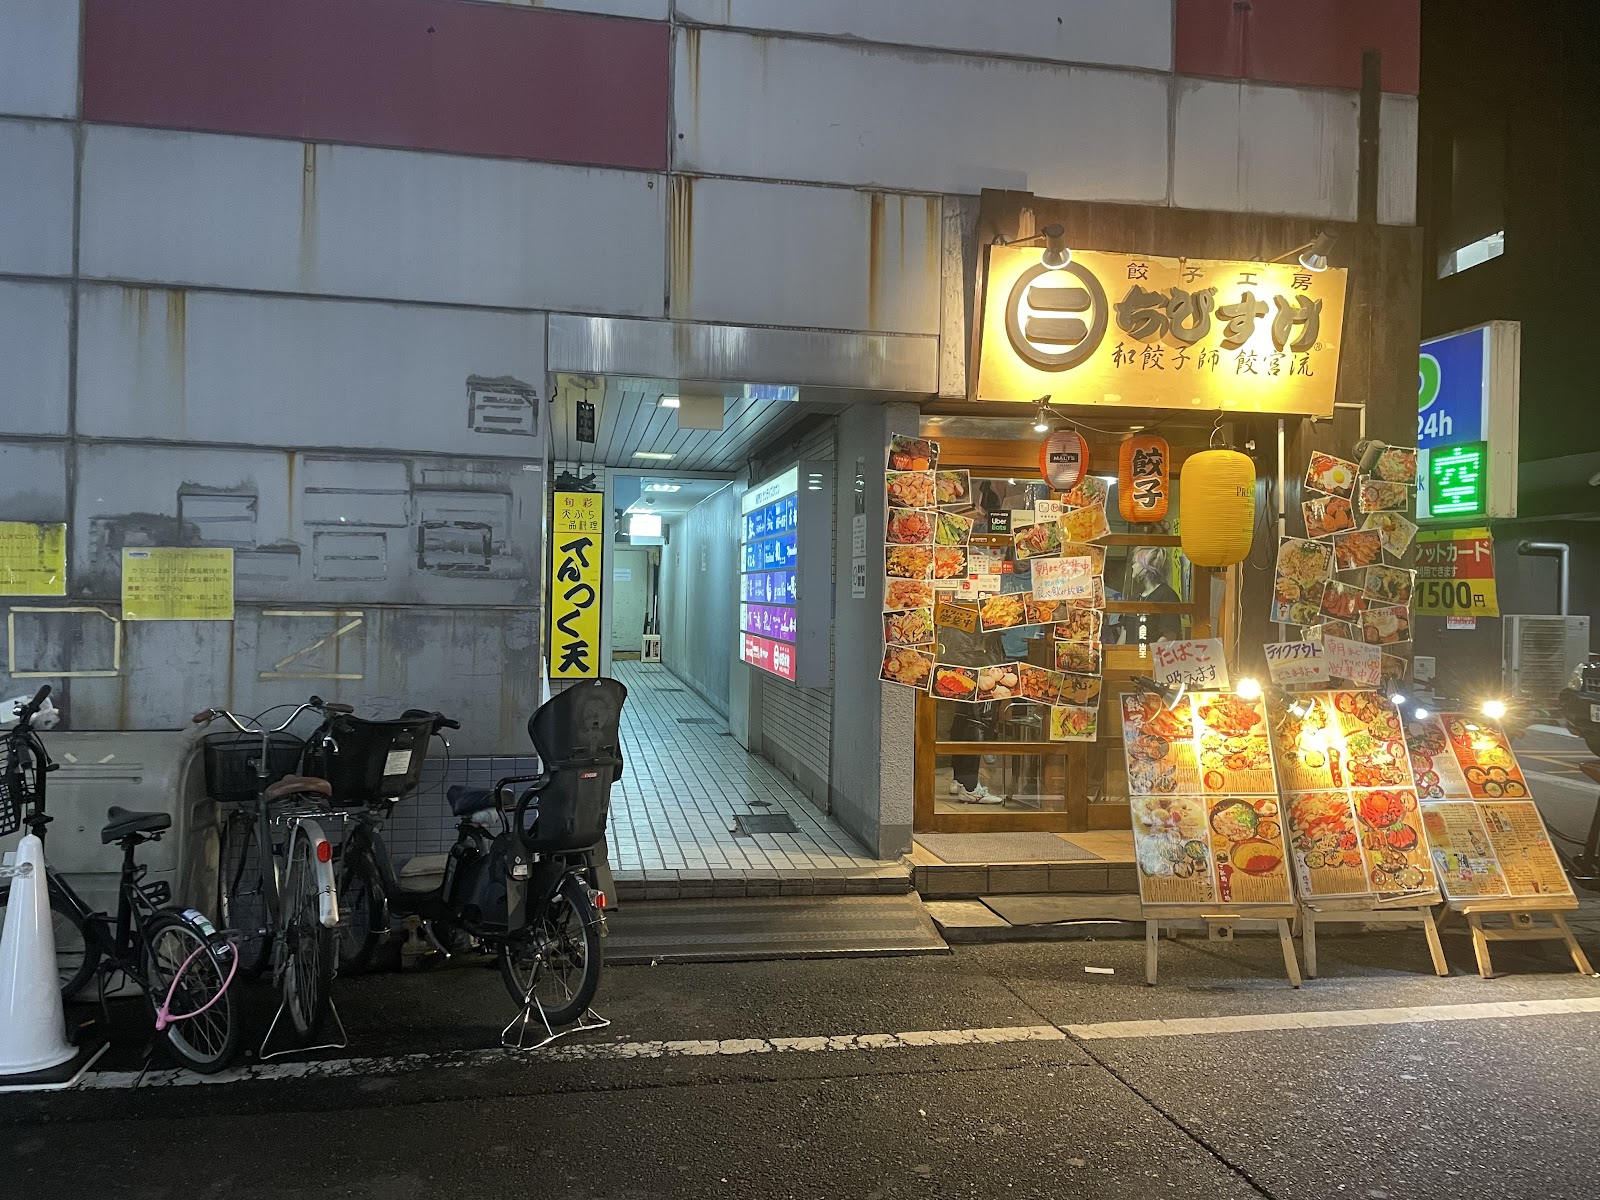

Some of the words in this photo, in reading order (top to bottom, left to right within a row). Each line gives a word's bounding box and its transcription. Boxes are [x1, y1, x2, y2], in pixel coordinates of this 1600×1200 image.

[1126, 262, 1313, 291] 餃子工房
[1114, 284, 1323, 352] ちびすけ
[1111, 342, 1220, 373] 和餃子師
[1132, 446, 1163, 509] 餃子
[1432, 447, 1480, 514] 空
[564, 497, 593, 508] 旬彩
[558, 520, 598, 530] 一品料理
[556, 536, 596, 673] てんつく天
[1155, 642, 1212, 668] たばこ
[1165, 664, 1217, 684] 吸えます
